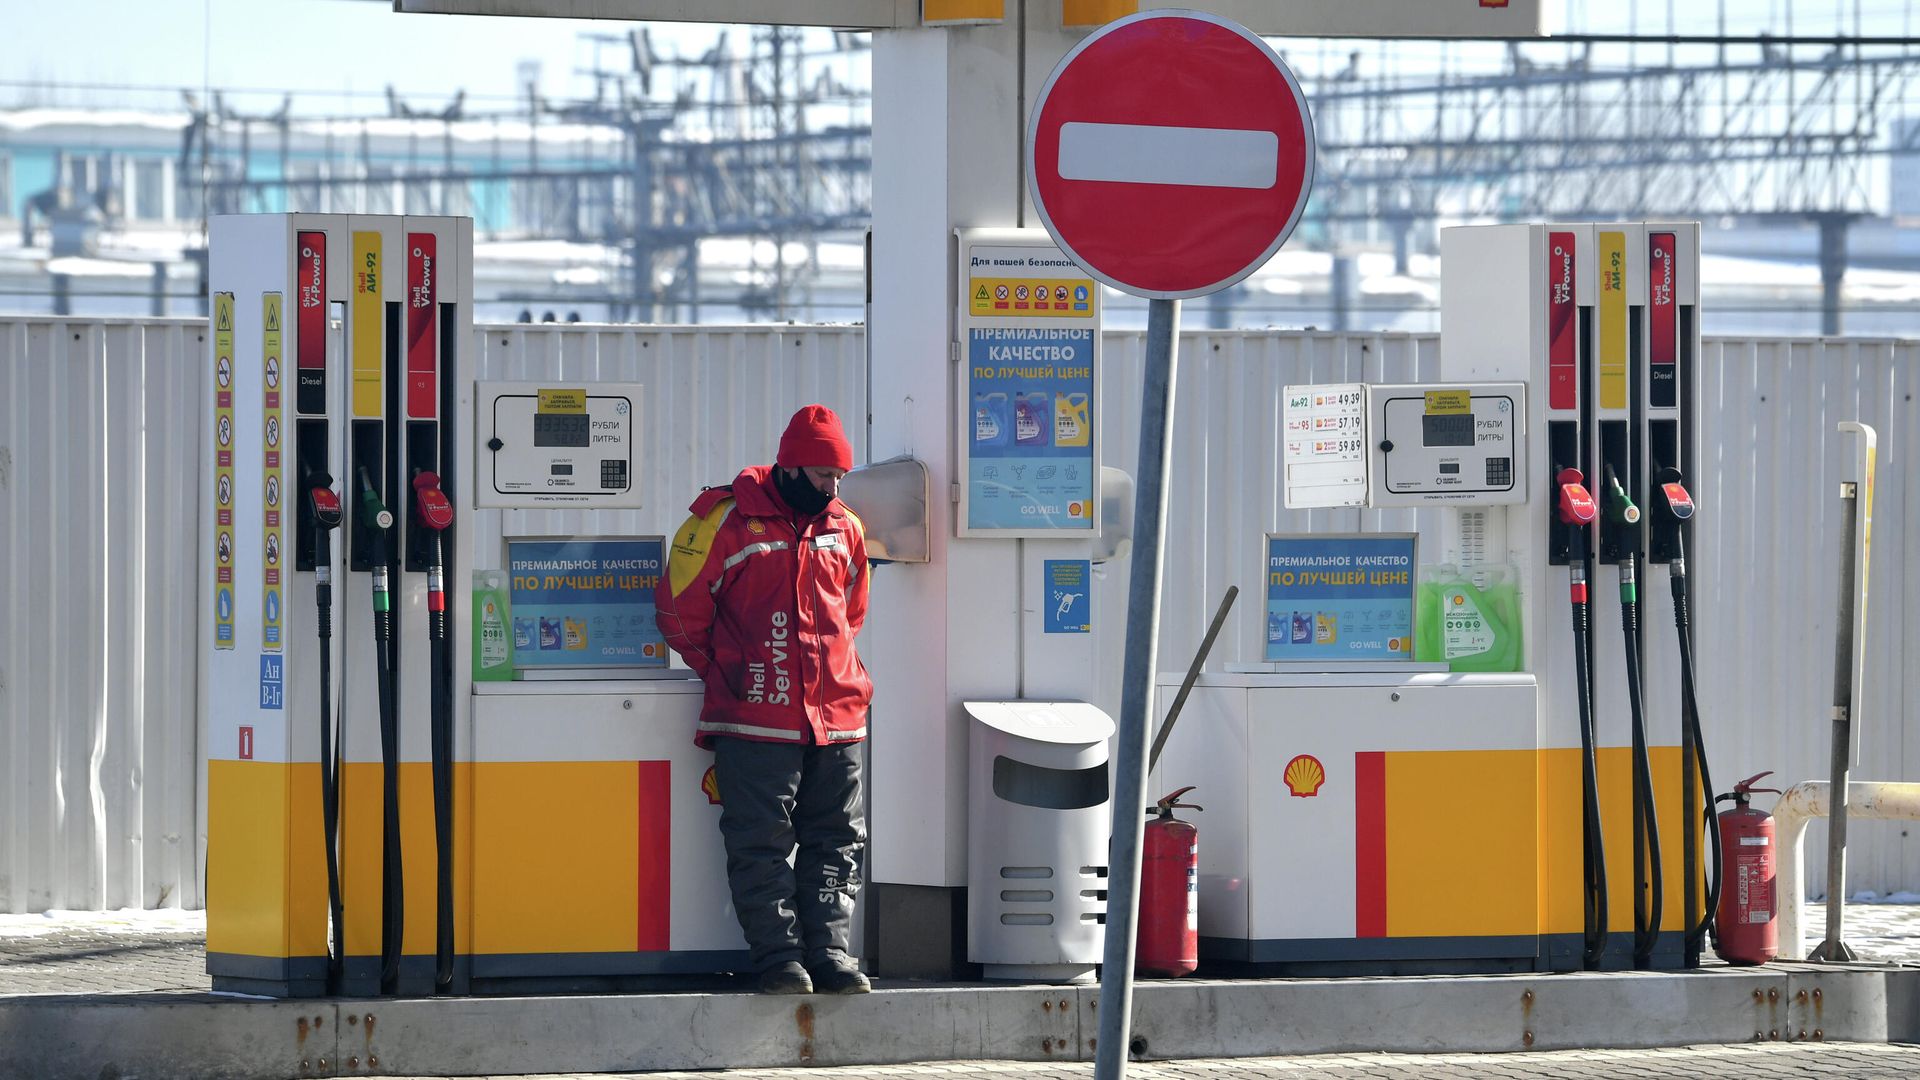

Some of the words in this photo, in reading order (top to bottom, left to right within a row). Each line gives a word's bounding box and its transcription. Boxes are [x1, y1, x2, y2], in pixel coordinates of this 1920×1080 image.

[971, 257, 990, 267] Для
[311, 252, 320, 307] V-Power
[421, 254, 431, 308] V-Power
[1562, 252, 1570, 304] V-Power
[1662, 252, 1671, 305] V-Power
[974, 329, 1090, 340] ПРЕМИАЛЬНОЕ
[989, 346, 1075, 361] КАЧЕСТВО
[974, 368, 994, 378] ПО
[998, 365, 1054, 378] ЛУЧШЕЙ
[1058, 367, 1089, 380] ЦЕНЕ
[1654, 371, 1673, 380] Diesel
[301, 377, 322, 385] Diesel
[1339, 393, 1360, 406] 49,39
[592, 421, 619, 430] РУБЛИ
[1301, 420, 1310, 430] 95
[1339, 417, 1360, 429] 57,19
[592, 435, 621, 443] ЛИТРЫ
[1339, 440, 1360, 452] 59,89
[1021, 506, 1036, 514] GO
[1037, 506, 1060, 514] WELL
[512, 560, 597, 571] ПРЕМИАЛЬНОЕ
[602, 560, 659, 570] КАЧЕСТВО
[1270, 557, 1350, 567] ПРЕМИАЛЬНОЕ
[1355, 556, 1408, 566] КАЧЕСТВО
[513, 576, 540, 591] ПО
[543, 572, 614, 590] ЛУЧШЕЙ
[1270, 572, 1295, 586] ПО
[1298, 568, 1366, 585] ЛУЧШЕЙ
[1370, 571, 1408, 587] ЦЕНЕ
[616, 647, 637, 655] WELL
[1350, 641, 1362, 649] GO
[1363, 641, 1382, 649] WELL
[764, 611, 790, 706] Service
[747, 663, 765, 704] Shell
